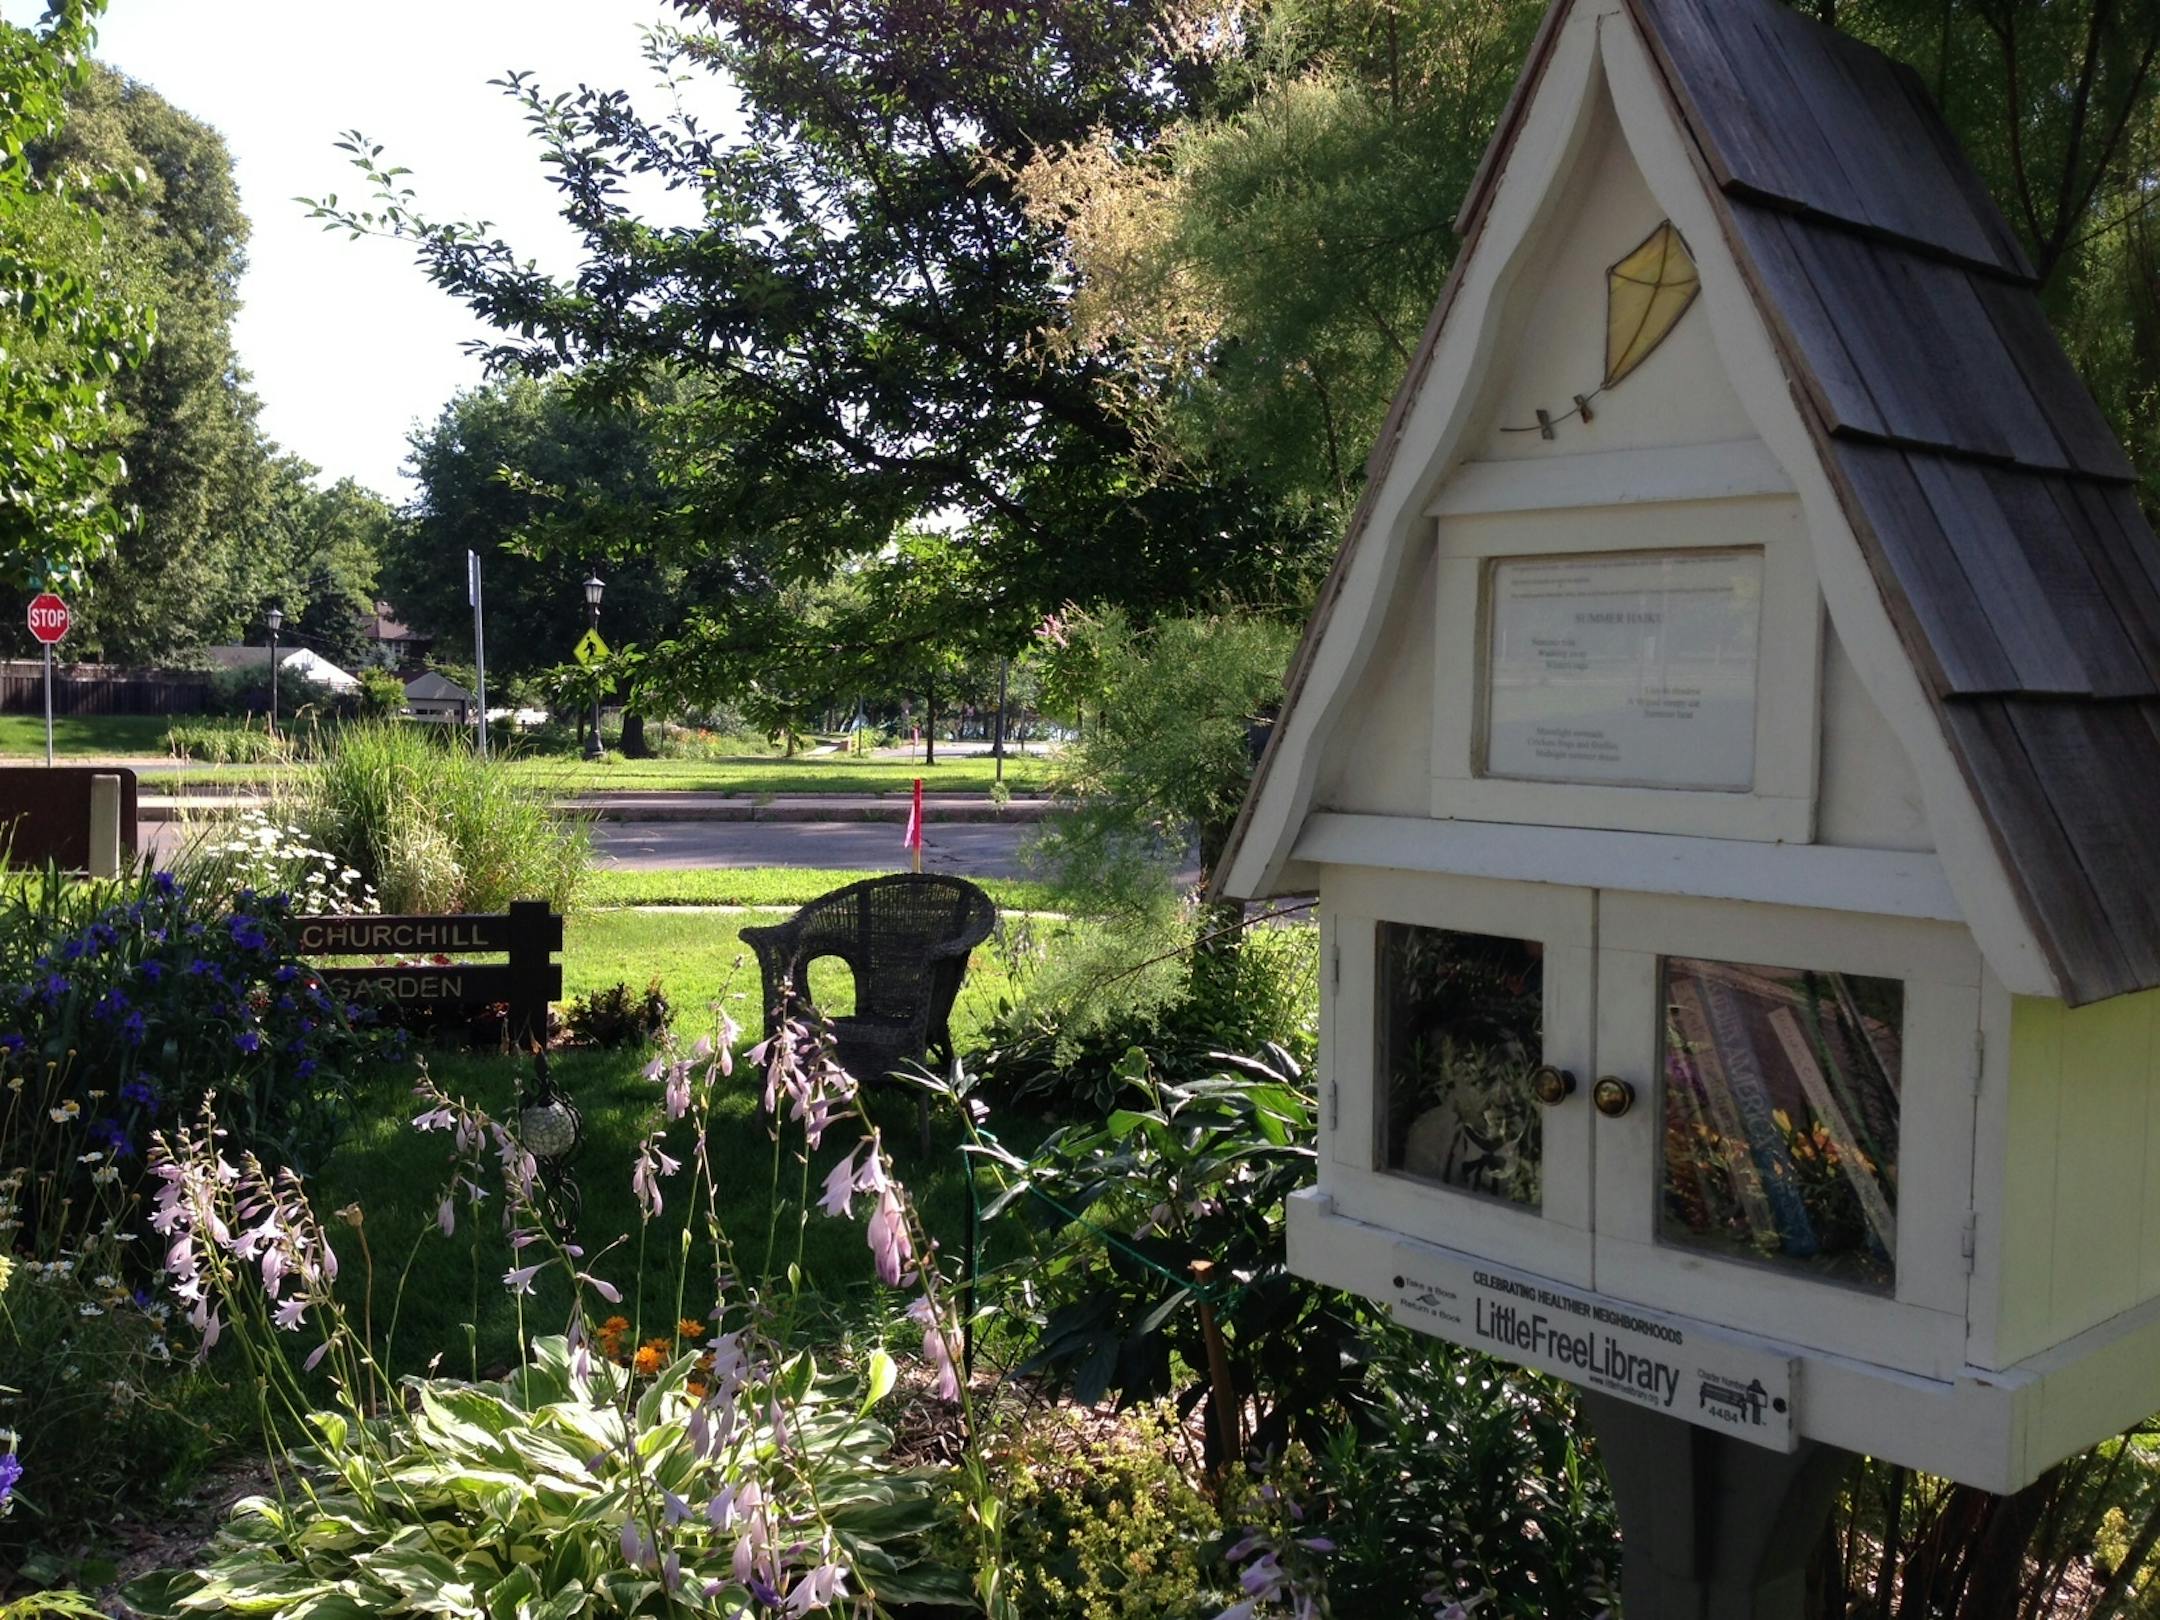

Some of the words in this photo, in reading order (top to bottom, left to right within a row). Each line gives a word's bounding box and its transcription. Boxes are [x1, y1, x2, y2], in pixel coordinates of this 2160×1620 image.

[31, 608, 66, 628] STOP
[303, 924, 489, 948] CHURCHILL
[330, 975, 462, 999] GARDEN
[1435, 1286, 1456, 1299] Book
[1400, 1298, 1429, 1314] Return
[1439, 1311, 1461, 1323] Book
[1473, 1271, 1536, 1301] CELEBRATING
[1538, 1290, 1591, 1318] HEALTHIER
[1593, 1306, 1683, 1345] NEIGHBORHOODS
[1708, 1406, 1738, 1424] 4484
